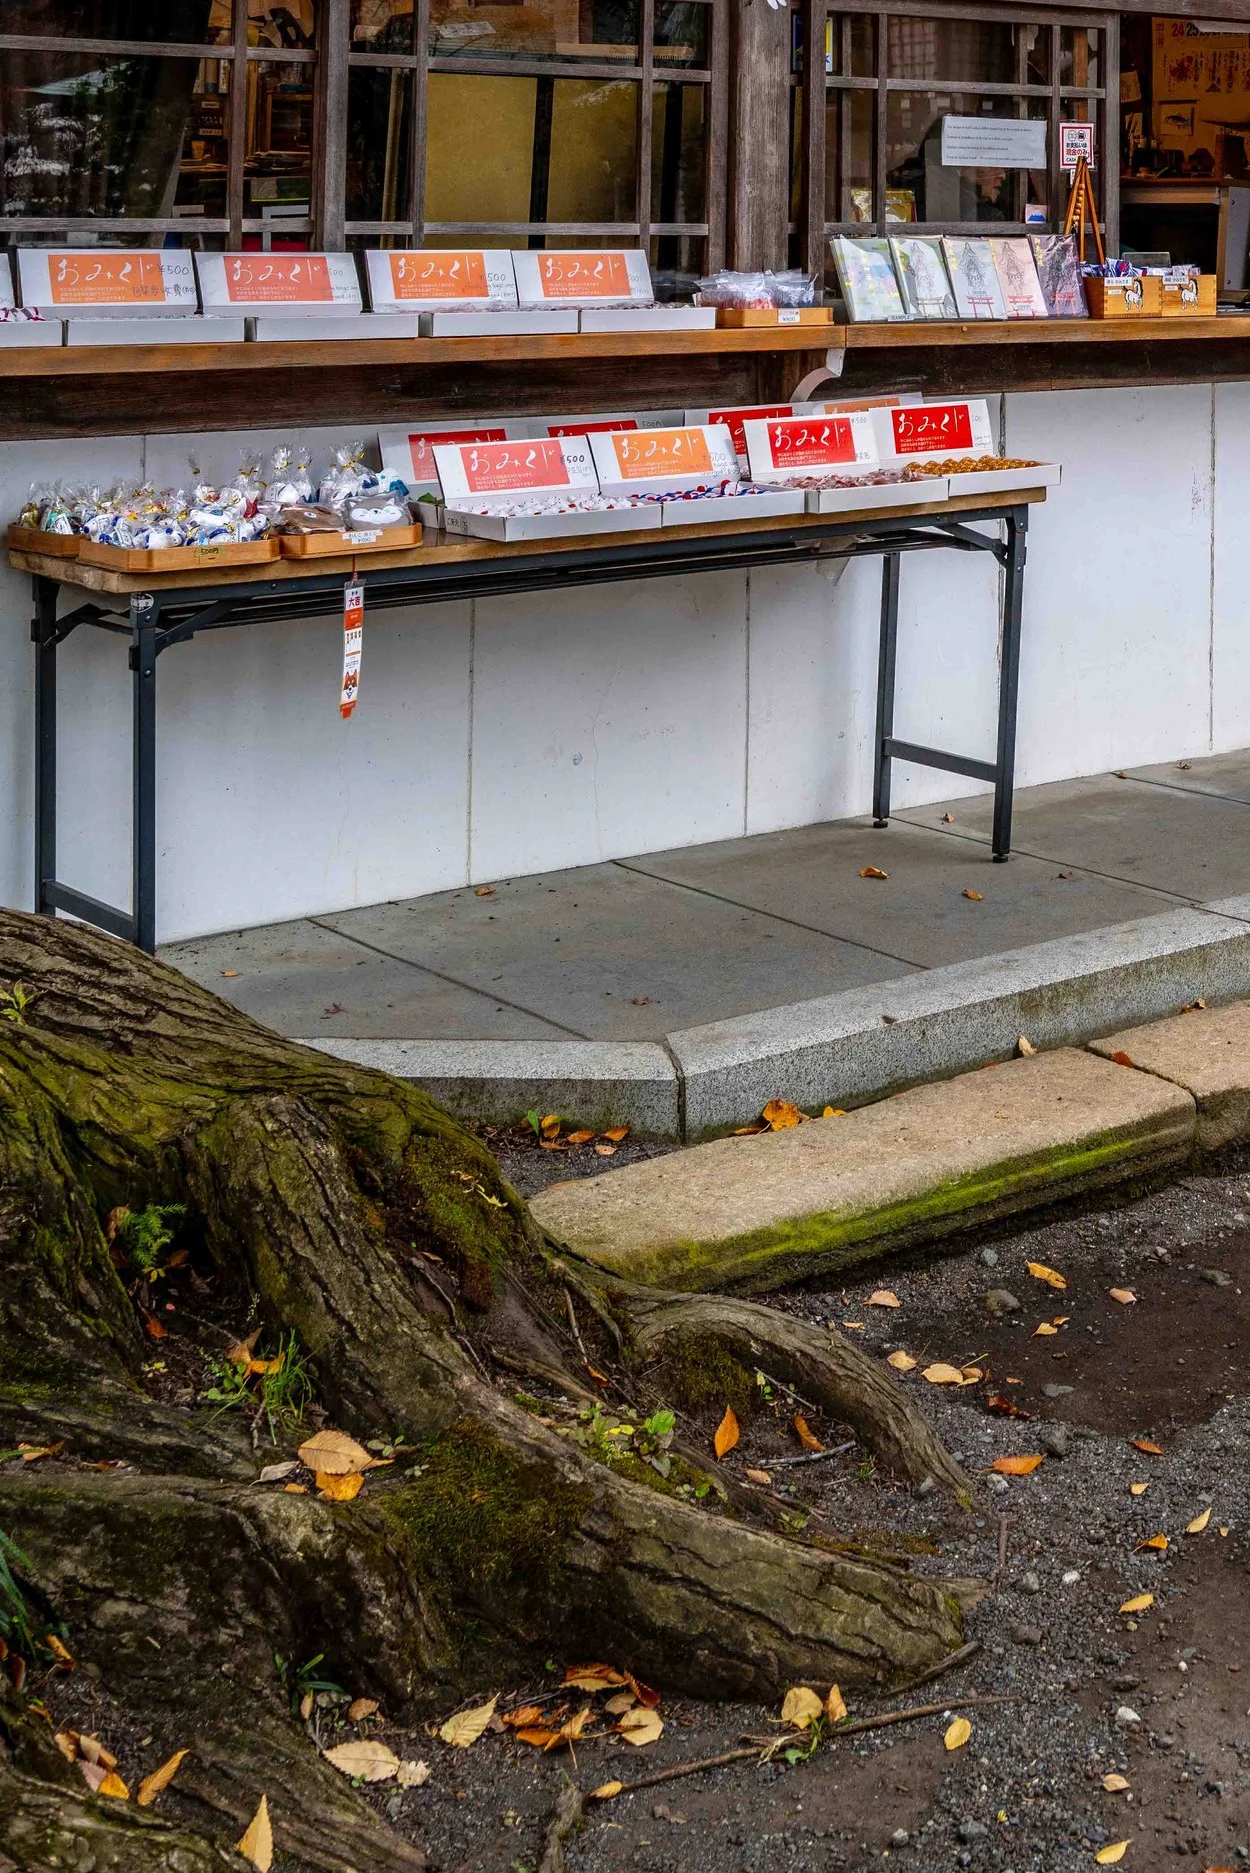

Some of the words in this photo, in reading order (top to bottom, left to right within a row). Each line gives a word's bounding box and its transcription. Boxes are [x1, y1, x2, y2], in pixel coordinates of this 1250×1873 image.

[57, 257, 154, 286] おみくじ
[232, 259, 321, 285] おみくじ
[397, 254, 478, 282] おみくじ
[545, 255, 620, 281] おみくじ
[775, 420, 846, 451] おみくじ
[898, 407, 965, 437] おみくじ
[469, 444, 556, 474] おみくじ
[620, 433, 700, 462] おみくじ
[348, 595, 361, 607] 大吉
